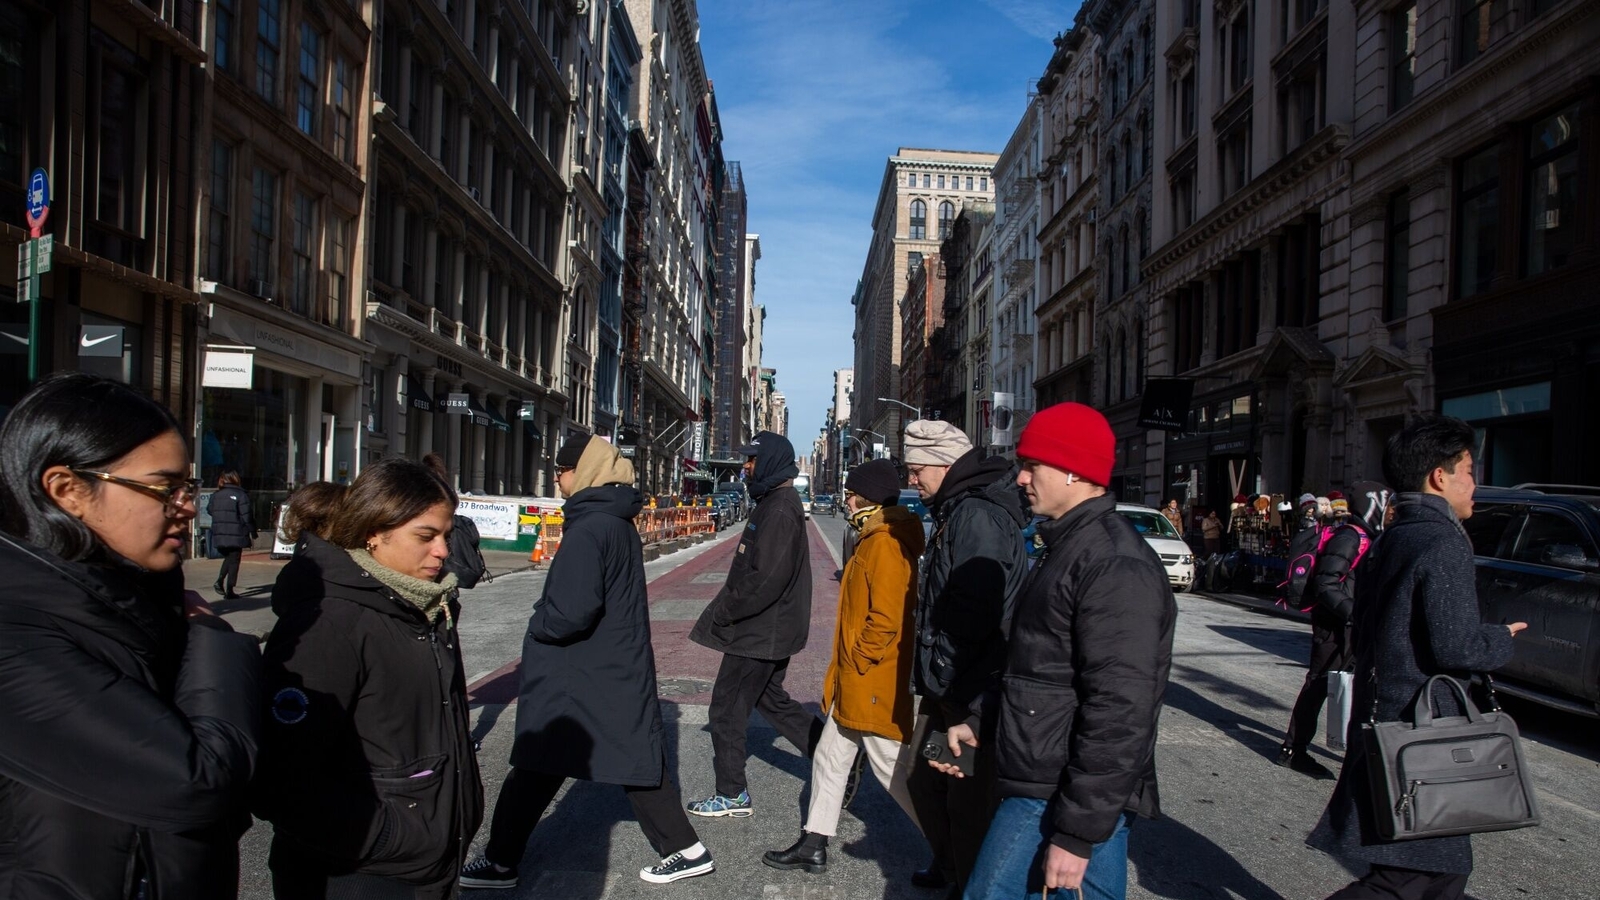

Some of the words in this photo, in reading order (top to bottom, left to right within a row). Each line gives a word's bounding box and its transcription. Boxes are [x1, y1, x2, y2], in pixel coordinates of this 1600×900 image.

[256, 330, 294, 350] UNFASHIONAL
[437, 356, 462, 377] GUESS
[413, 398, 430, 411] GUESS
[694, 422, 702, 459] SEPHORA
